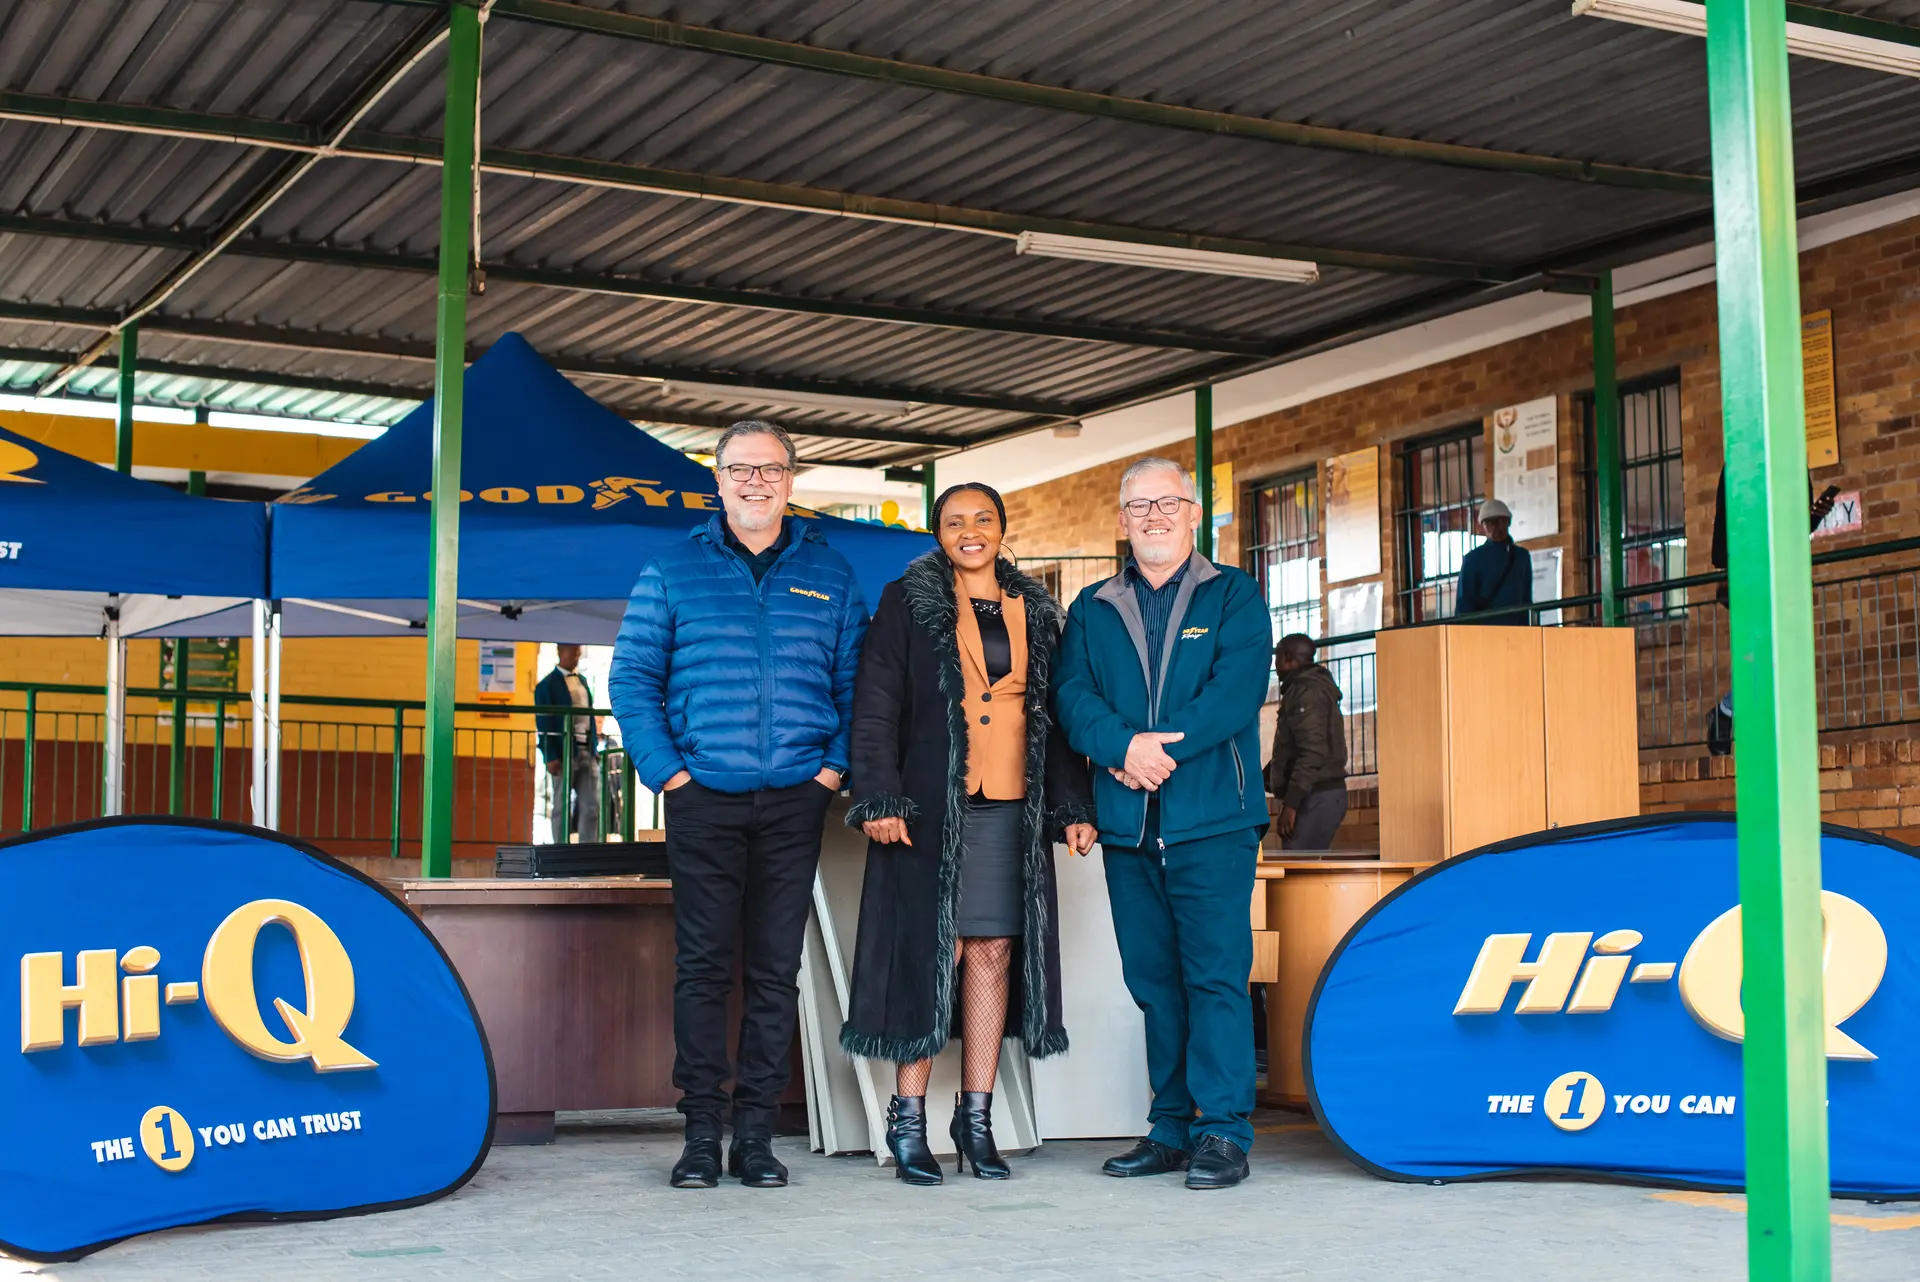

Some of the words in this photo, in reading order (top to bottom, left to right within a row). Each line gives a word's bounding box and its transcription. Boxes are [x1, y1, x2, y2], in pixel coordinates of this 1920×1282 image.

[790, 587, 830, 601] GOODYEAR
[21, 898, 379, 1073] Hi-Q
[1487, 1094, 1535, 1114] THE
[1559, 1078, 1588, 1120] 1
[1613, 1094, 1672, 1114] YOU
[1678, 1094, 1736, 1115] CAN
[91, 1137, 136, 1163] THE
[155, 1112, 182, 1161] 1
[198, 1123, 247, 1148] YOU
[252, 1117, 297, 1141] CAN
[301, 1110, 362, 1135] TRUST
